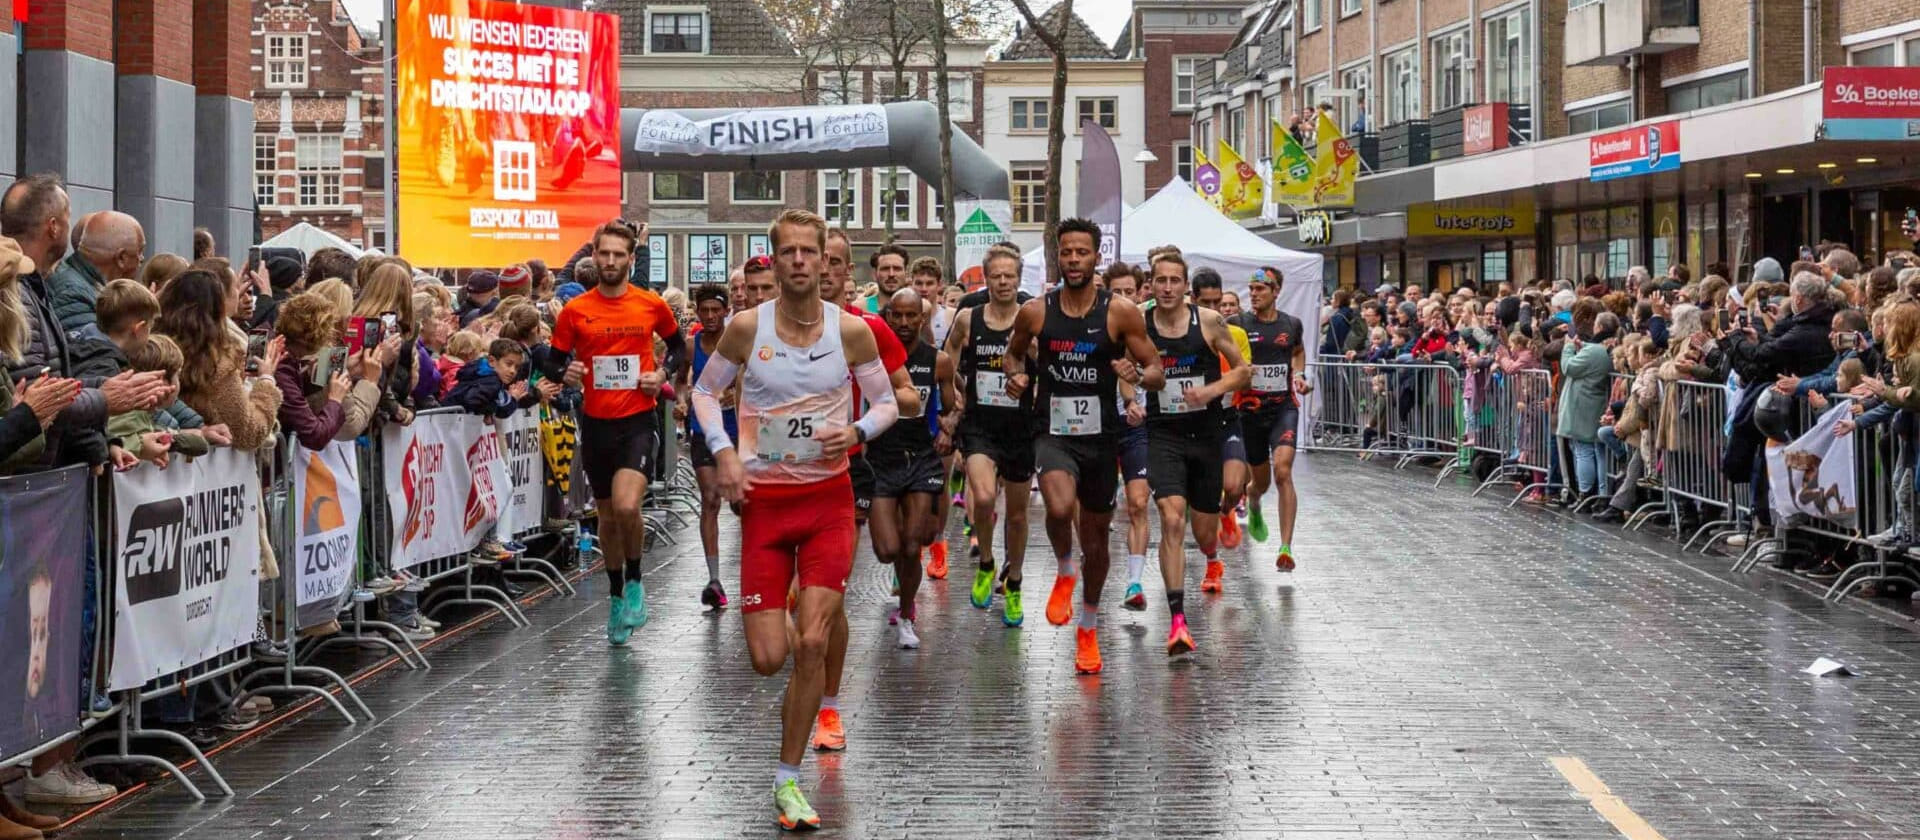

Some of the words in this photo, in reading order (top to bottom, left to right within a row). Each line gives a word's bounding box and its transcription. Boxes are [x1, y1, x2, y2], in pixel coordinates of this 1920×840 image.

[429, 14, 455, 40] WIJ
[461, 19, 520, 47] WENSEN
[523, 25, 589, 54] IEDEREEN
[443, 47, 514, 80] SUCCES
[517, 53, 552, 83] MET
[556, 58, 579, 86] DE
[431, 79, 591, 117] DRECHTSTADLOOP
[1864, 86, 1920, 100] Boeke
[641, 127, 700, 144] FORTIUS
[709, 116, 814, 146] FINISH
[824, 123, 885, 136] FORTIUS
[469, 207, 521, 229] RESPONZ
[523, 209, 560, 230] MEDIA
[1433, 213, 1515, 232] Intertoys
[616, 358, 629, 372] 18
[1062, 366, 1098, 381] VMB
[1263, 366, 1286, 378] 1284
[1073, 400, 1089, 416] 12
[788, 417, 812, 438] 25
[185, 483, 245, 540] RUNNERS
[121, 522, 182, 579] RW
[184, 536, 231, 591] WORLD
